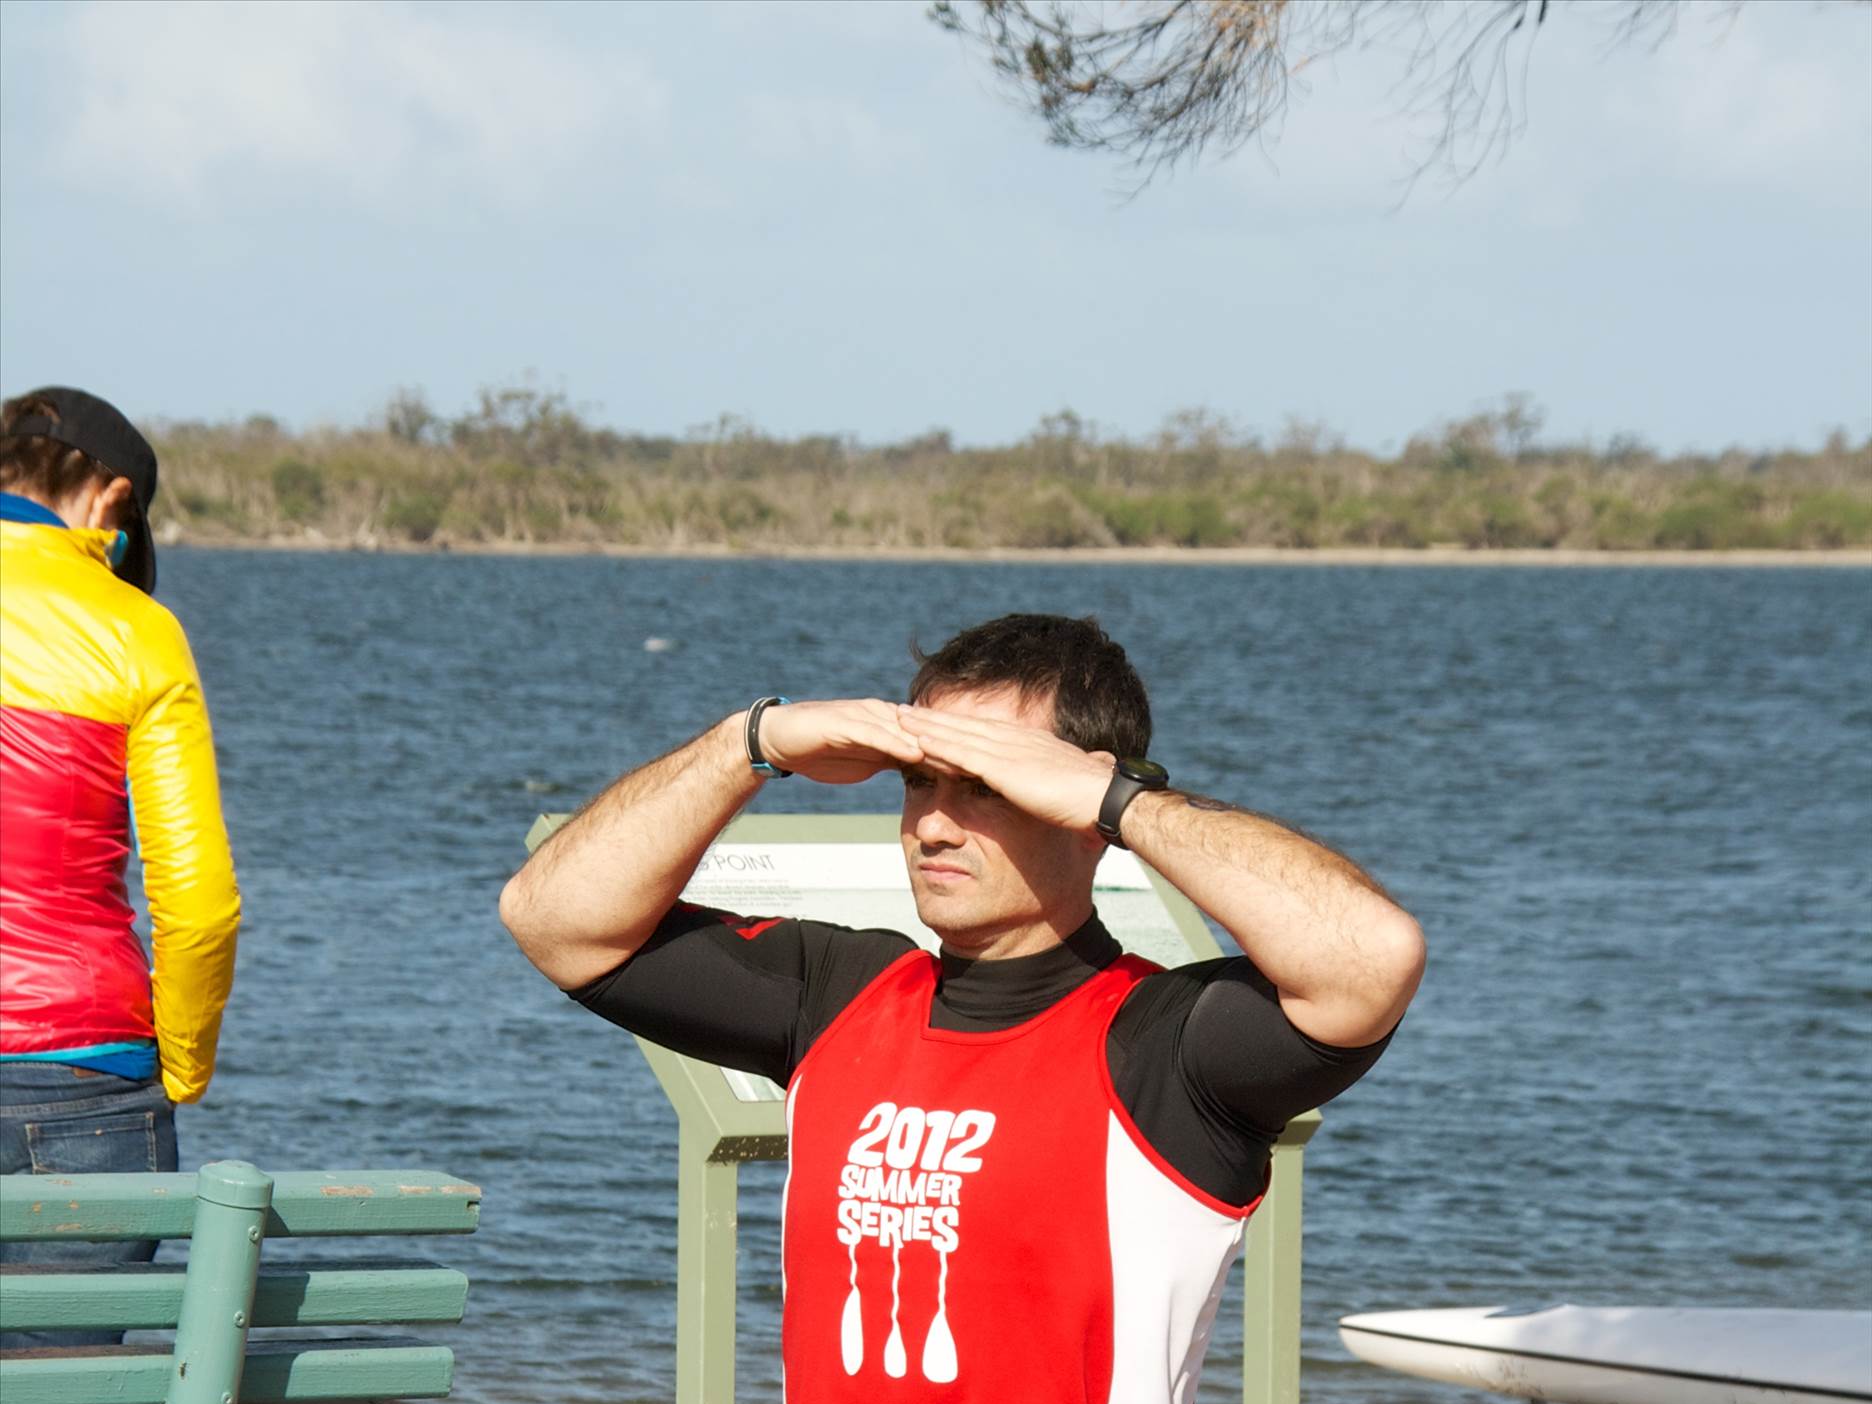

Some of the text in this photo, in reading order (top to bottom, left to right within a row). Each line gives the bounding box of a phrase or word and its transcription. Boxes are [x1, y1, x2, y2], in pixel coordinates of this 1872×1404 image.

[713, 854, 775, 871] POINT
[847, 1101, 997, 1173] 2012
[837, 1164, 963, 1206] SUMMER
[837, 1198, 959, 1253] SERIES
